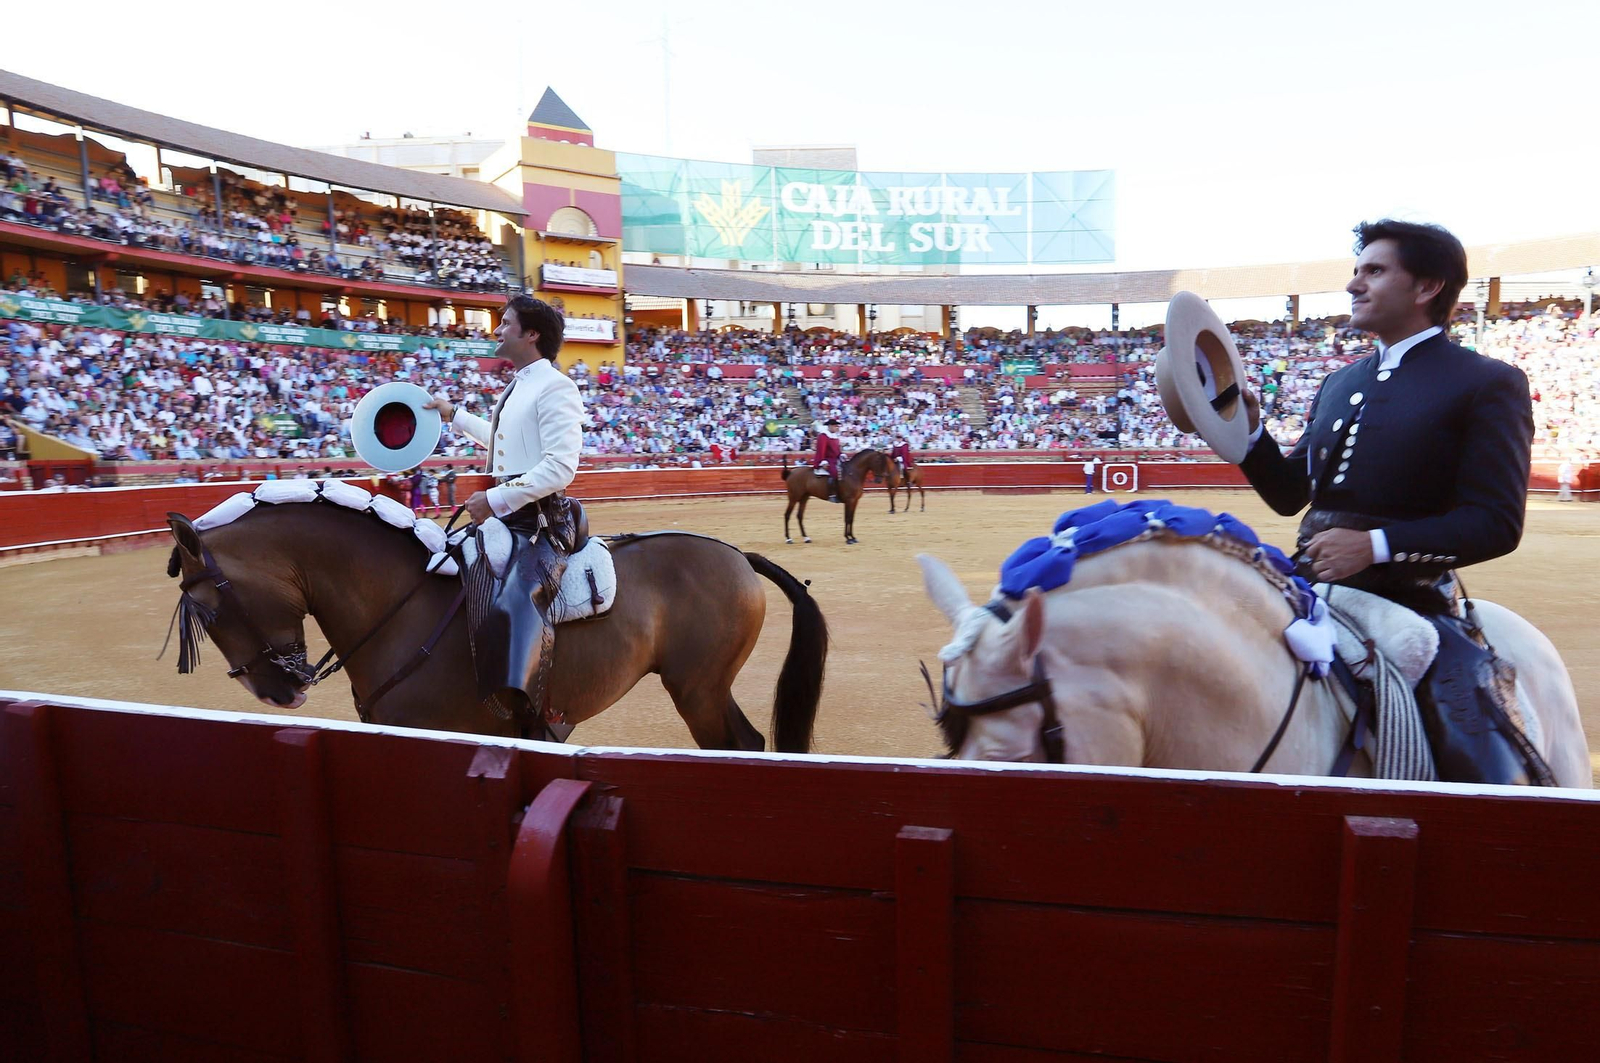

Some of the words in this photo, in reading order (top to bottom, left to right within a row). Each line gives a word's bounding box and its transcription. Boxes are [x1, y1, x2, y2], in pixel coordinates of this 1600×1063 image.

[780, 182, 879, 217] CAJA
[887, 186, 1022, 216] RURAL
[810, 220, 896, 252] DEL
[909, 222, 993, 252] SUR
